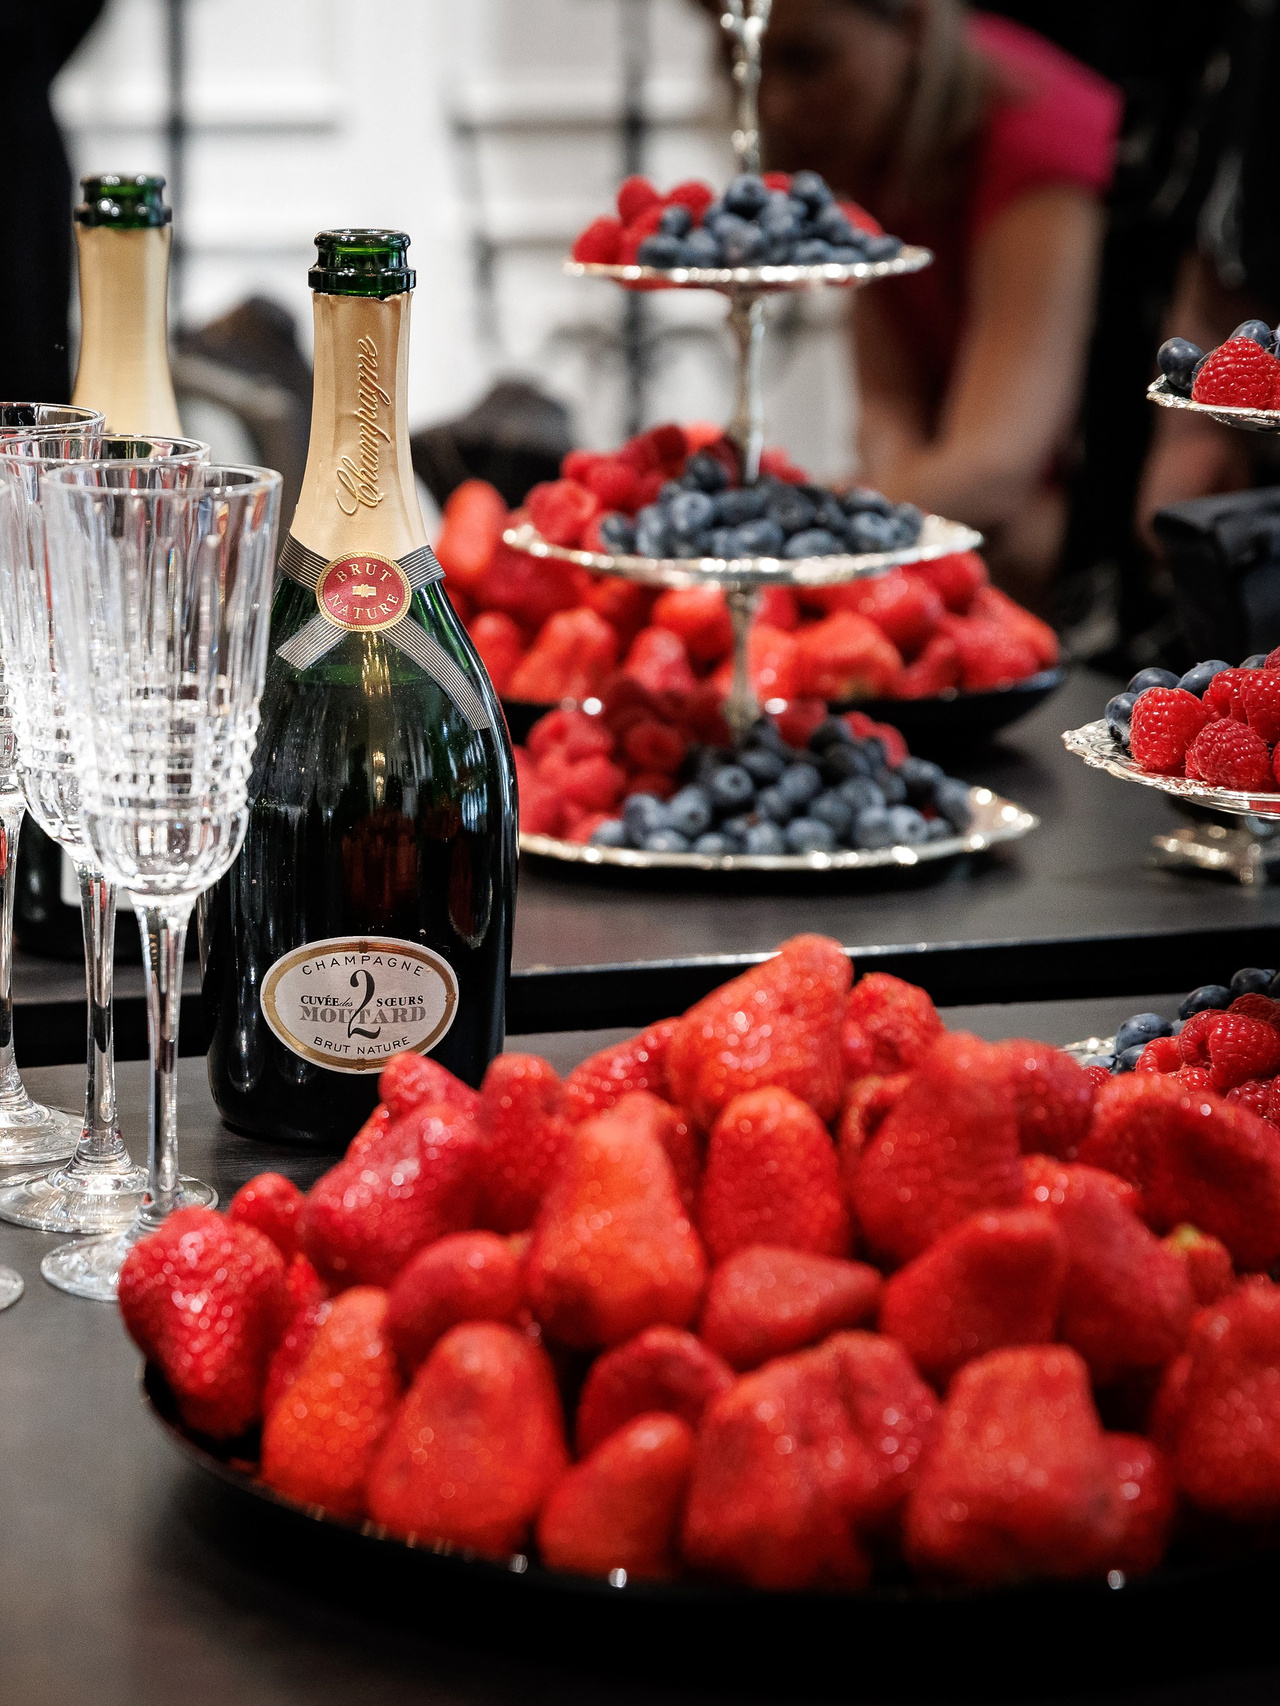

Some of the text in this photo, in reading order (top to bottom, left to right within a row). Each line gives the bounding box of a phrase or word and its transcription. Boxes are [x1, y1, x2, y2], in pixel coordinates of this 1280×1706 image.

[335, 334, 391, 516] Champagne
[335, 562, 392, 583] BRUT
[328, 593, 399, 620] NATURE
[302, 955, 424, 977] CHAMPAGNE
[299, 1005, 427, 1025] MOUTARD
[300, 969, 424, 1039] CUVÉE des 2 SŒURS
[313, 1036, 411, 1055] BRUT NATURE
